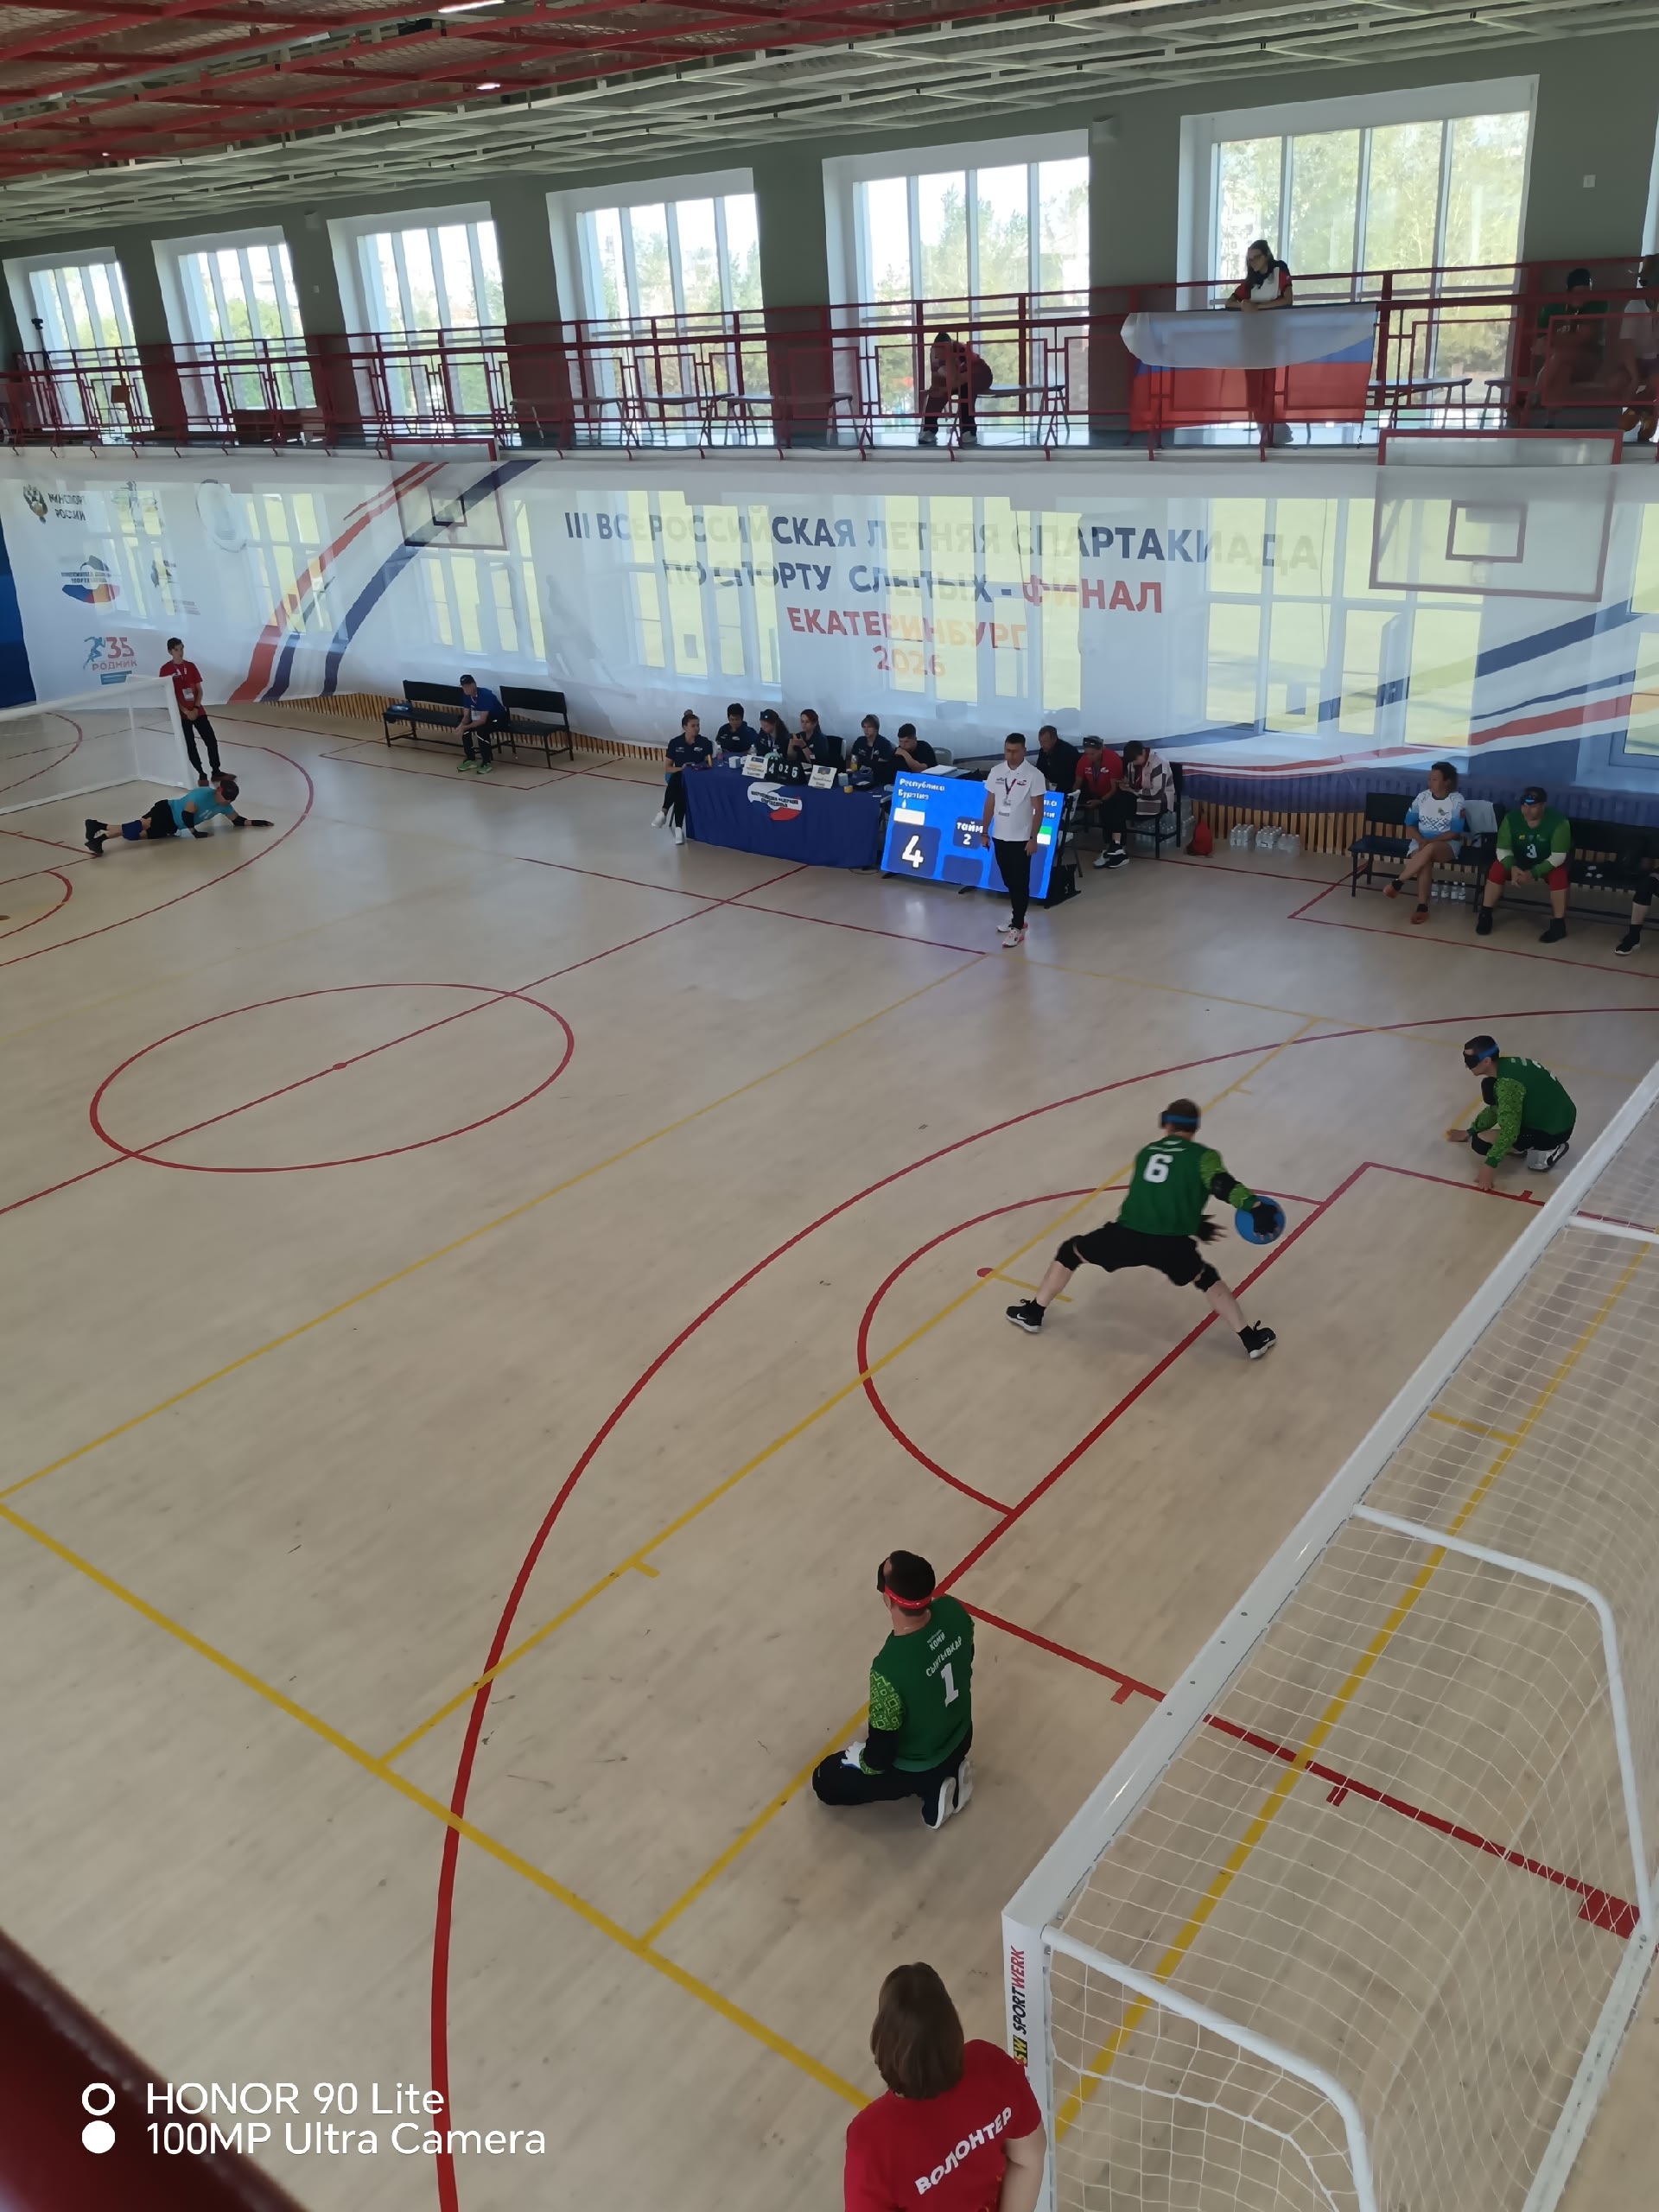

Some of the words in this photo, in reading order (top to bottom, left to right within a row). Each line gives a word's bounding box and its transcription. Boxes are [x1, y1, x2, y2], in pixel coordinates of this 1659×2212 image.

[564, 512, 591, 539] III
[596, 507, 856, 547] ВСЕРОССИЙСКАЯ
[868, 520, 999, 554] ЛЕТНЯЯ
[1011, 523, 1319, 575] СПАРТАКИАДА
[662, 559, 707, 587] ПО
[714, 562, 831, 591] СПОРТУ
[849, 564, 994, 603] СЛЕПЫХ
[1022, 574, 1162, 613] ФИНАЛ
[786, 607, 1027, 650] ЕКАТЕРИНБУРГ
[106, 637, 135, 658] 35
[873, 645, 946, 677] 2026
[92, 659, 137, 671] РОДНИК
[957, 821, 983, 834] тайм
[963, 834, 971, 845] 2
[901, 836, 925, 868] 4
[1526, 843, 1537, 858] 3
[1143, 1154, 1173, 1183] 6
[926, 1636, 962, 1677] СЫКТЫВКАР
[929, 1631, 945, 1650] КОМИ
[941, 1662, 959, 1707] 1
[1011, 1945, 1027, 2035] SPORTWERK
[914, 2107, 1012, 2196] ВОЛОНТЕР
